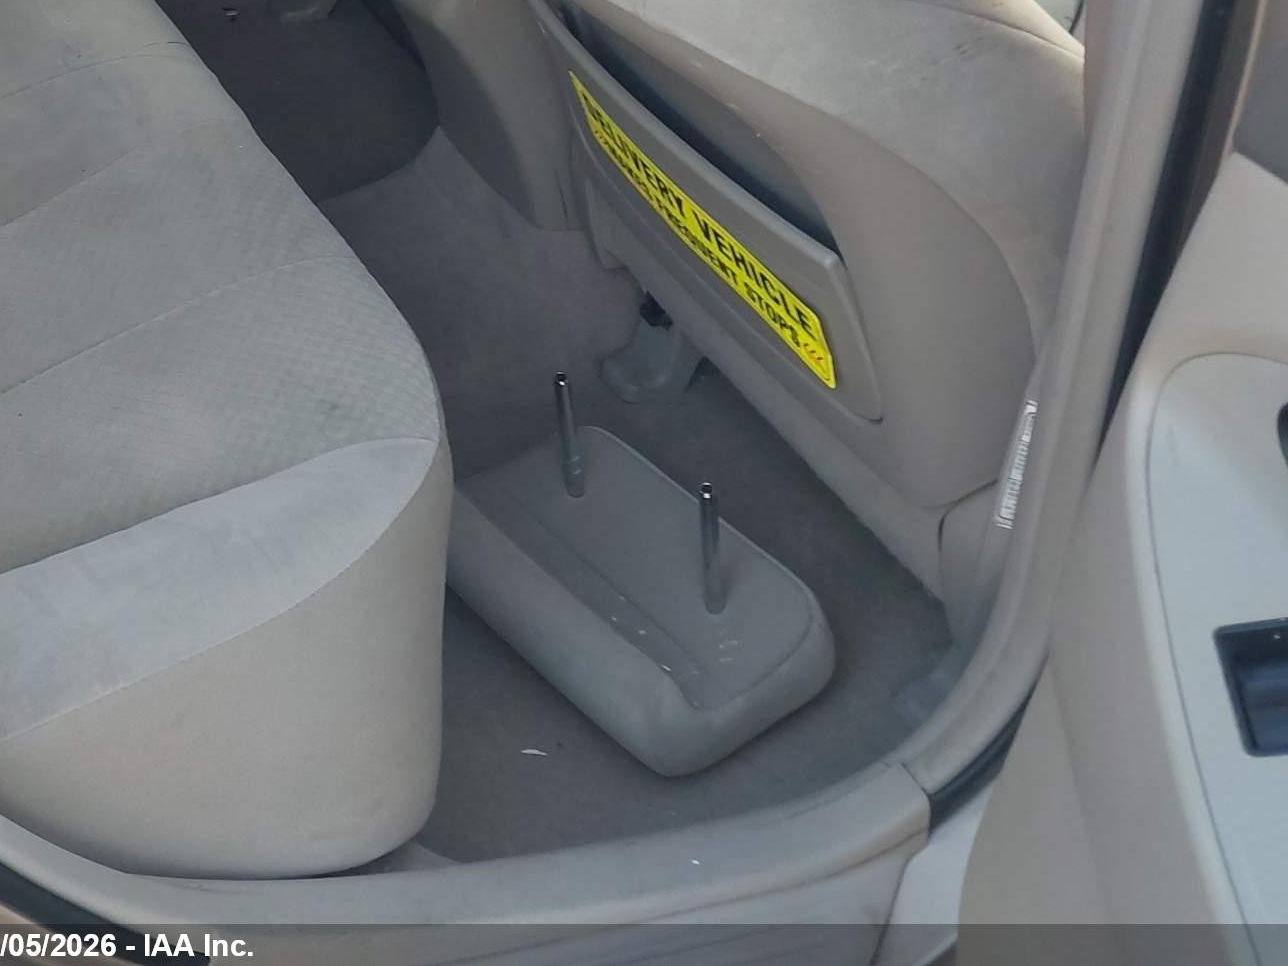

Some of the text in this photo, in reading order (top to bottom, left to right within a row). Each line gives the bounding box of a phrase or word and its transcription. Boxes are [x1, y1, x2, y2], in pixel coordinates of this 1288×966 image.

[581, 91, 685, 220] DELIVERY
[693, 210, 816, 341] VEHICLE
[743, 281, 802, 348] STOPS
